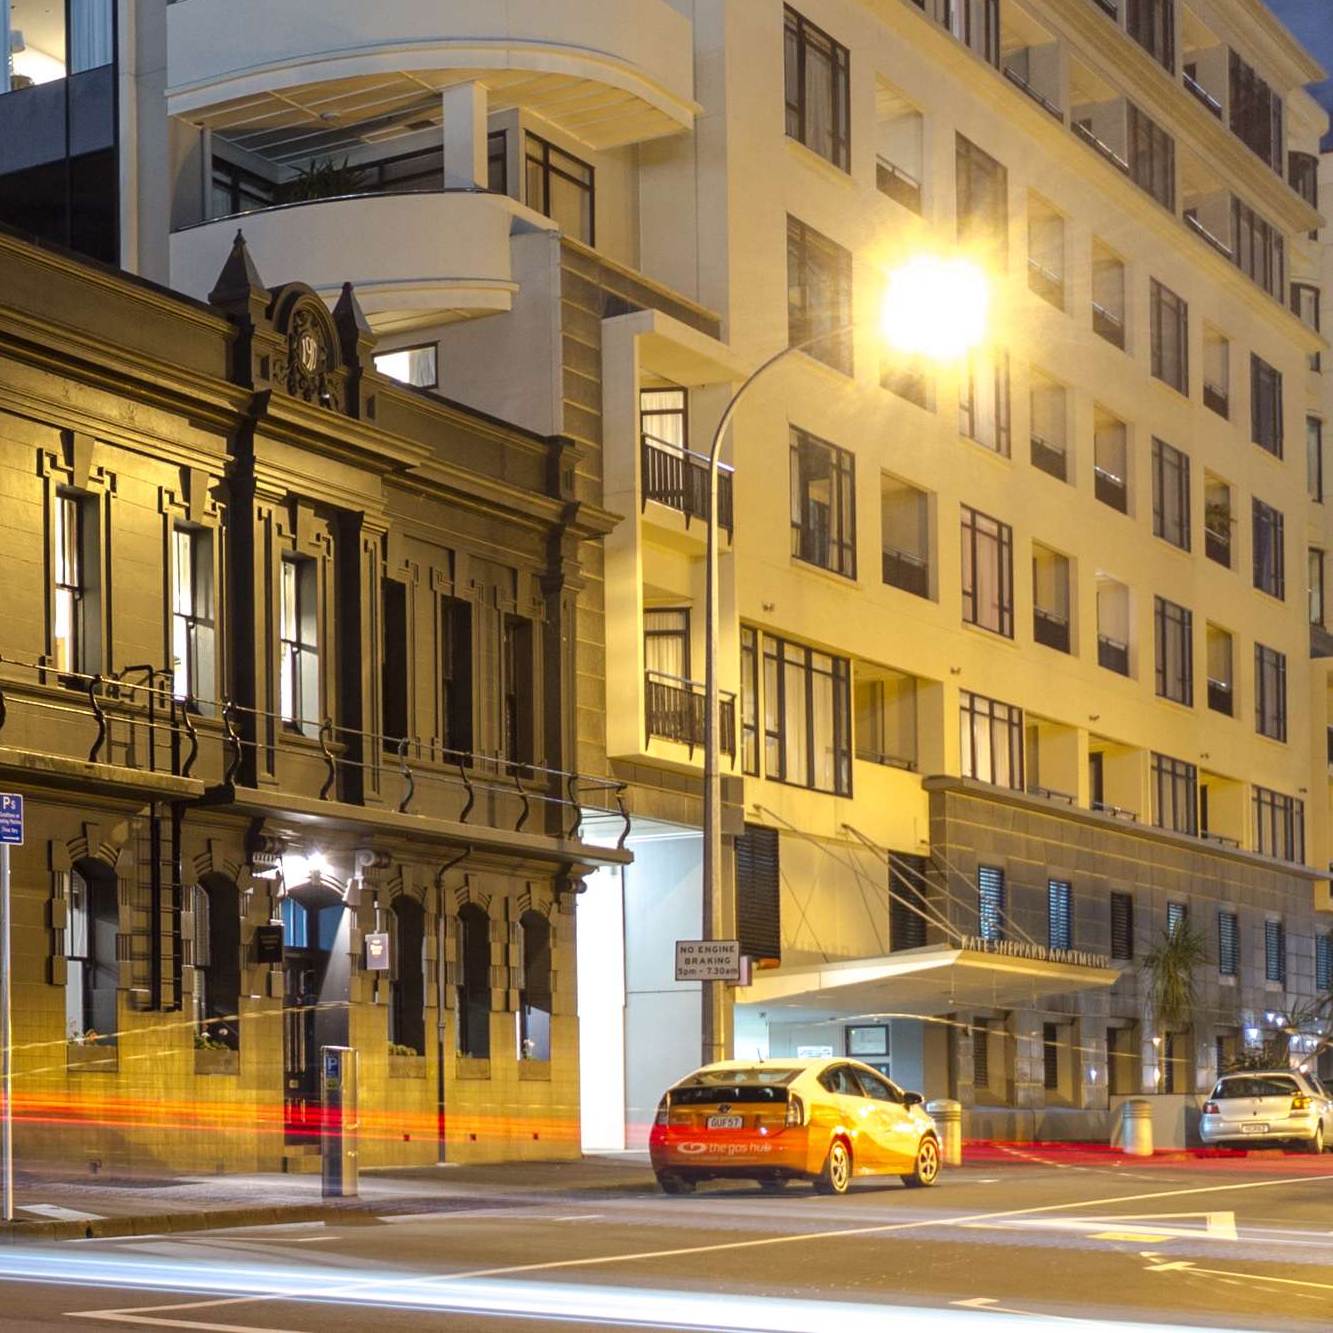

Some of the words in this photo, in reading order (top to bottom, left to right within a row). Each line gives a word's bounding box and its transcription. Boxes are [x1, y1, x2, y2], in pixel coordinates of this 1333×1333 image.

[680, 946, 694, 954] NO
[698, 946, 735, 954] ENGINE
[961, 935, 989, 953] KATE
[993, 939, 1047, 960] SHEPPARD
[1048, 948, 1110, 969] APARTMENTS
[684, 957, 731, 965] BRAKING
[678, 968, 697, 976] 5pm
[328, 1057, 338, 1070] P
[709, 1143, 727, 1153] the
[728, 1144, 748, 1155] gas
[750, 1142, 773, 1153] hub
